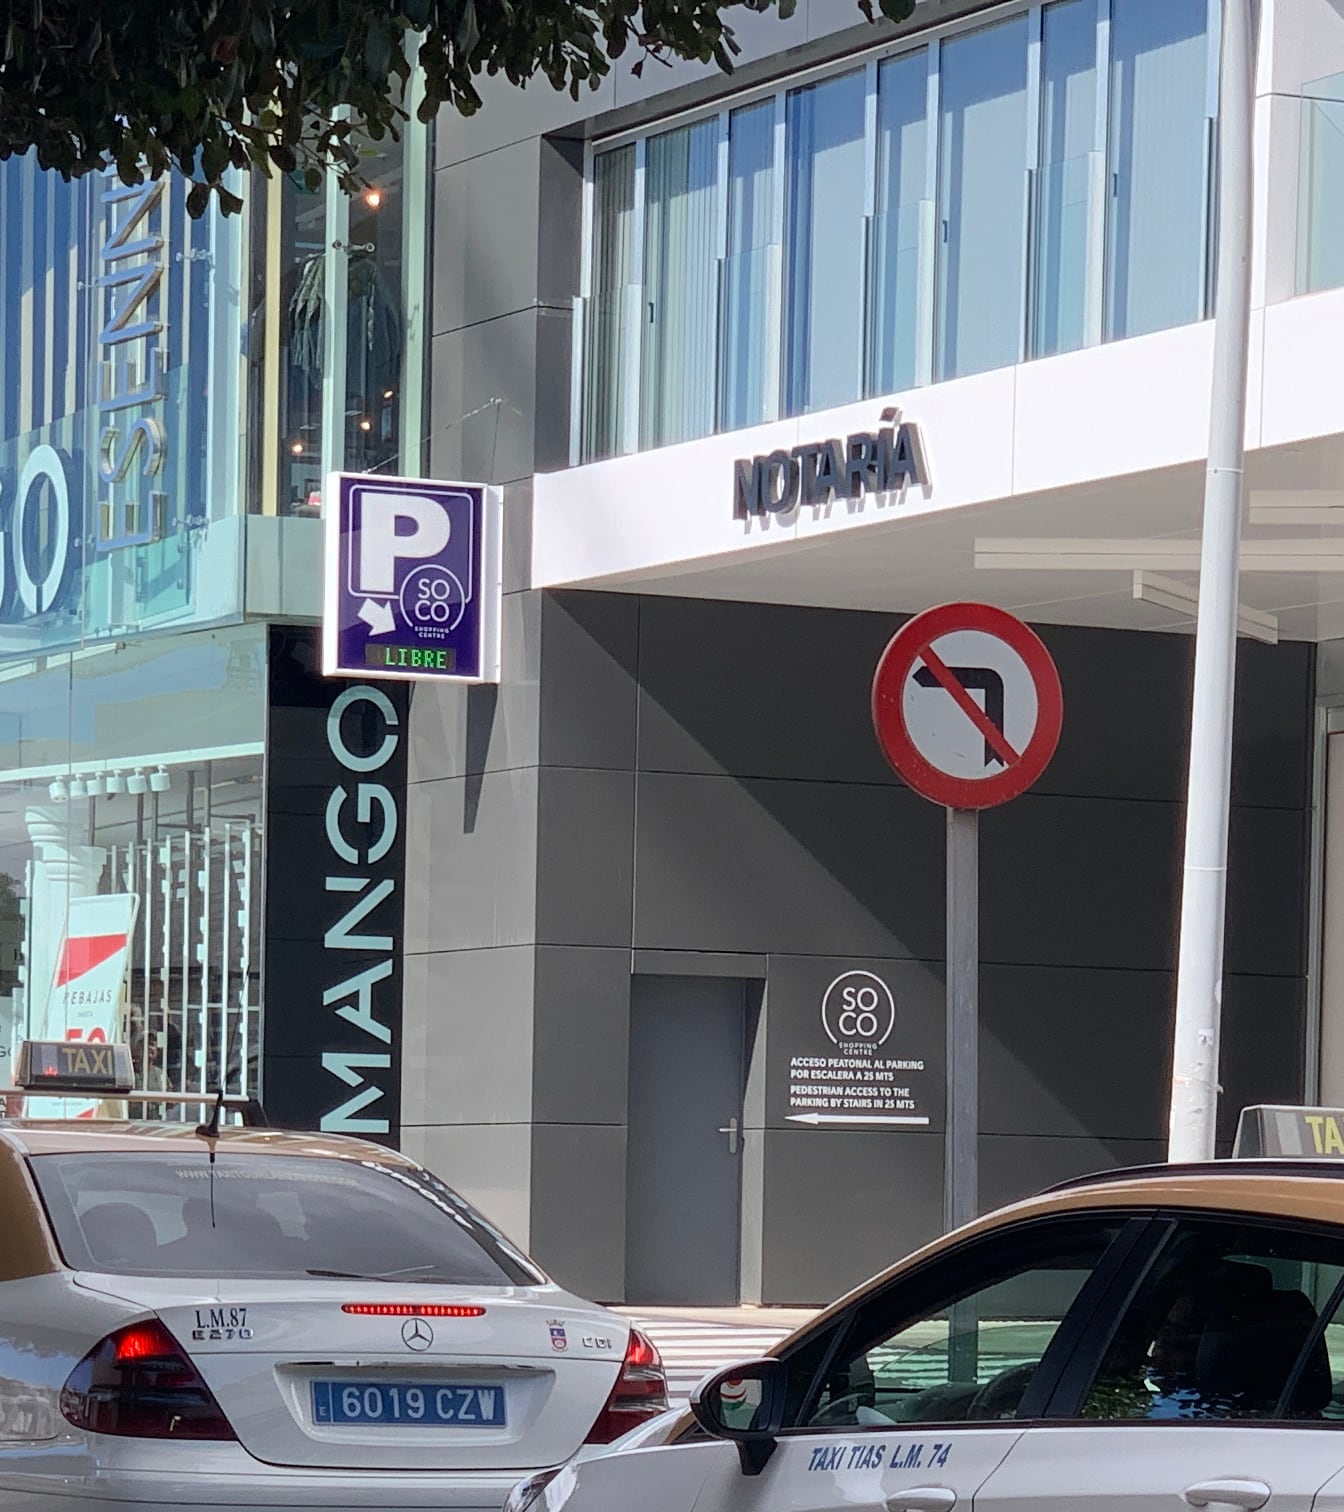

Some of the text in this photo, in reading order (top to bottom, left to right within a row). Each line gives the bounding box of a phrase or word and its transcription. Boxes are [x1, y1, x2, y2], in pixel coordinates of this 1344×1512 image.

[733, 407, 930, 520] NOTARÍA
[360, 492, 451, 593] P
[415, 625, 450, 634] SHOPPING
[418, 632, 445, 640] CENTRE
[384, 647, 448, 669] LIBRE
[320, 684, 399, 1134] MANGO
[63, 989, 112, 1004] REBAJAS
[62, 1047, 114, 1075] TAXI
[790, 1057, 924, 1070] ACCESO PEATONAL AL PARKING
[790, 1070, 894, 1081] POR ESCALERA A 25 MTS
[790, 1085, 909, 1097] PEDESTRIAN ACCESS TO THE
[790, 1097, 915, 1109] PARKING BY STAIRS IN 25 MTS
[195, 1308, 248, 1329] L.M.87
[582, 1337, 613, 1349] CDI
[319, 1387, 496, 1421] E 6019 CZW
[808, 1443, 952, 1471] TAXI TIAS L.M. 74
